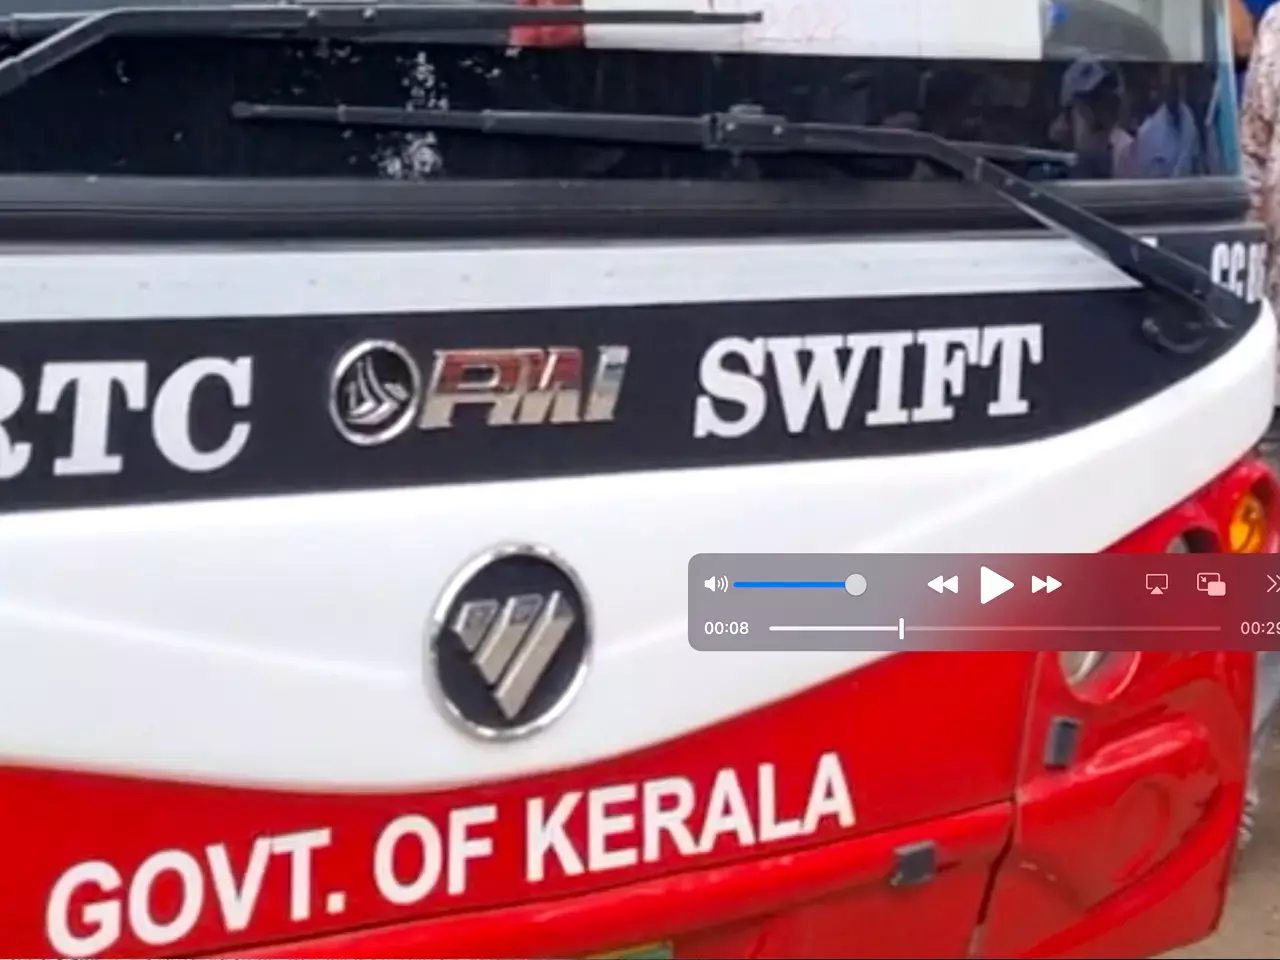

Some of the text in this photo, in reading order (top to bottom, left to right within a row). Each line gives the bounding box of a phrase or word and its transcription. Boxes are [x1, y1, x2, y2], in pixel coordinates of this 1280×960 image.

[693, 323, 1043, 438] SWIFT
[45, 751, 857, 959] GOVT. OF KERALA
